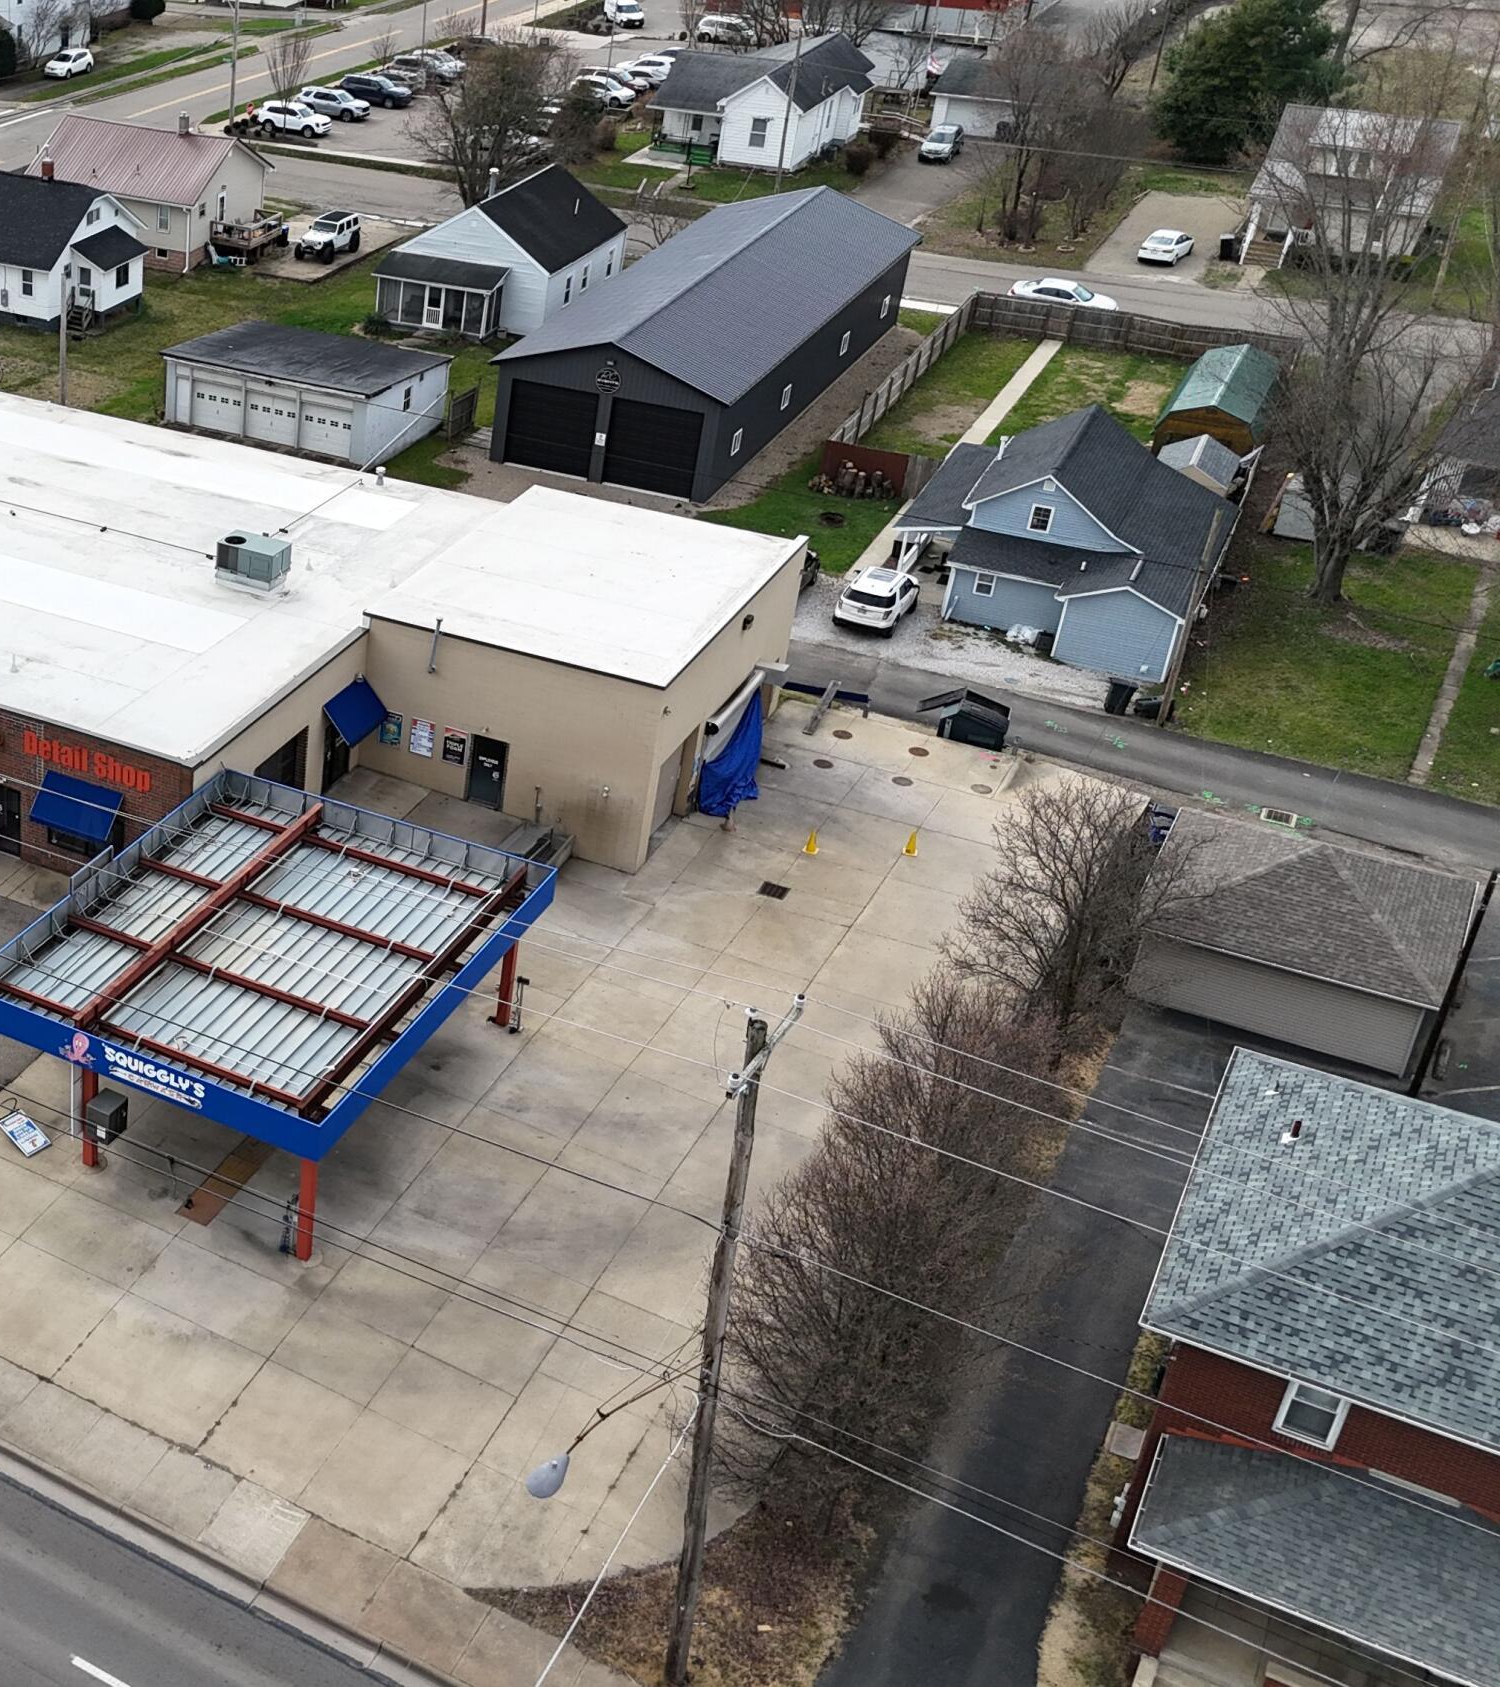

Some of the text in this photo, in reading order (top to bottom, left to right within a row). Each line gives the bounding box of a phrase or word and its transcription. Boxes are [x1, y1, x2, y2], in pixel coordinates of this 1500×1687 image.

[23, 730, 151, 793] Detail Shop
[102, 1043, 205, 1098] SQUIGGLY'S
